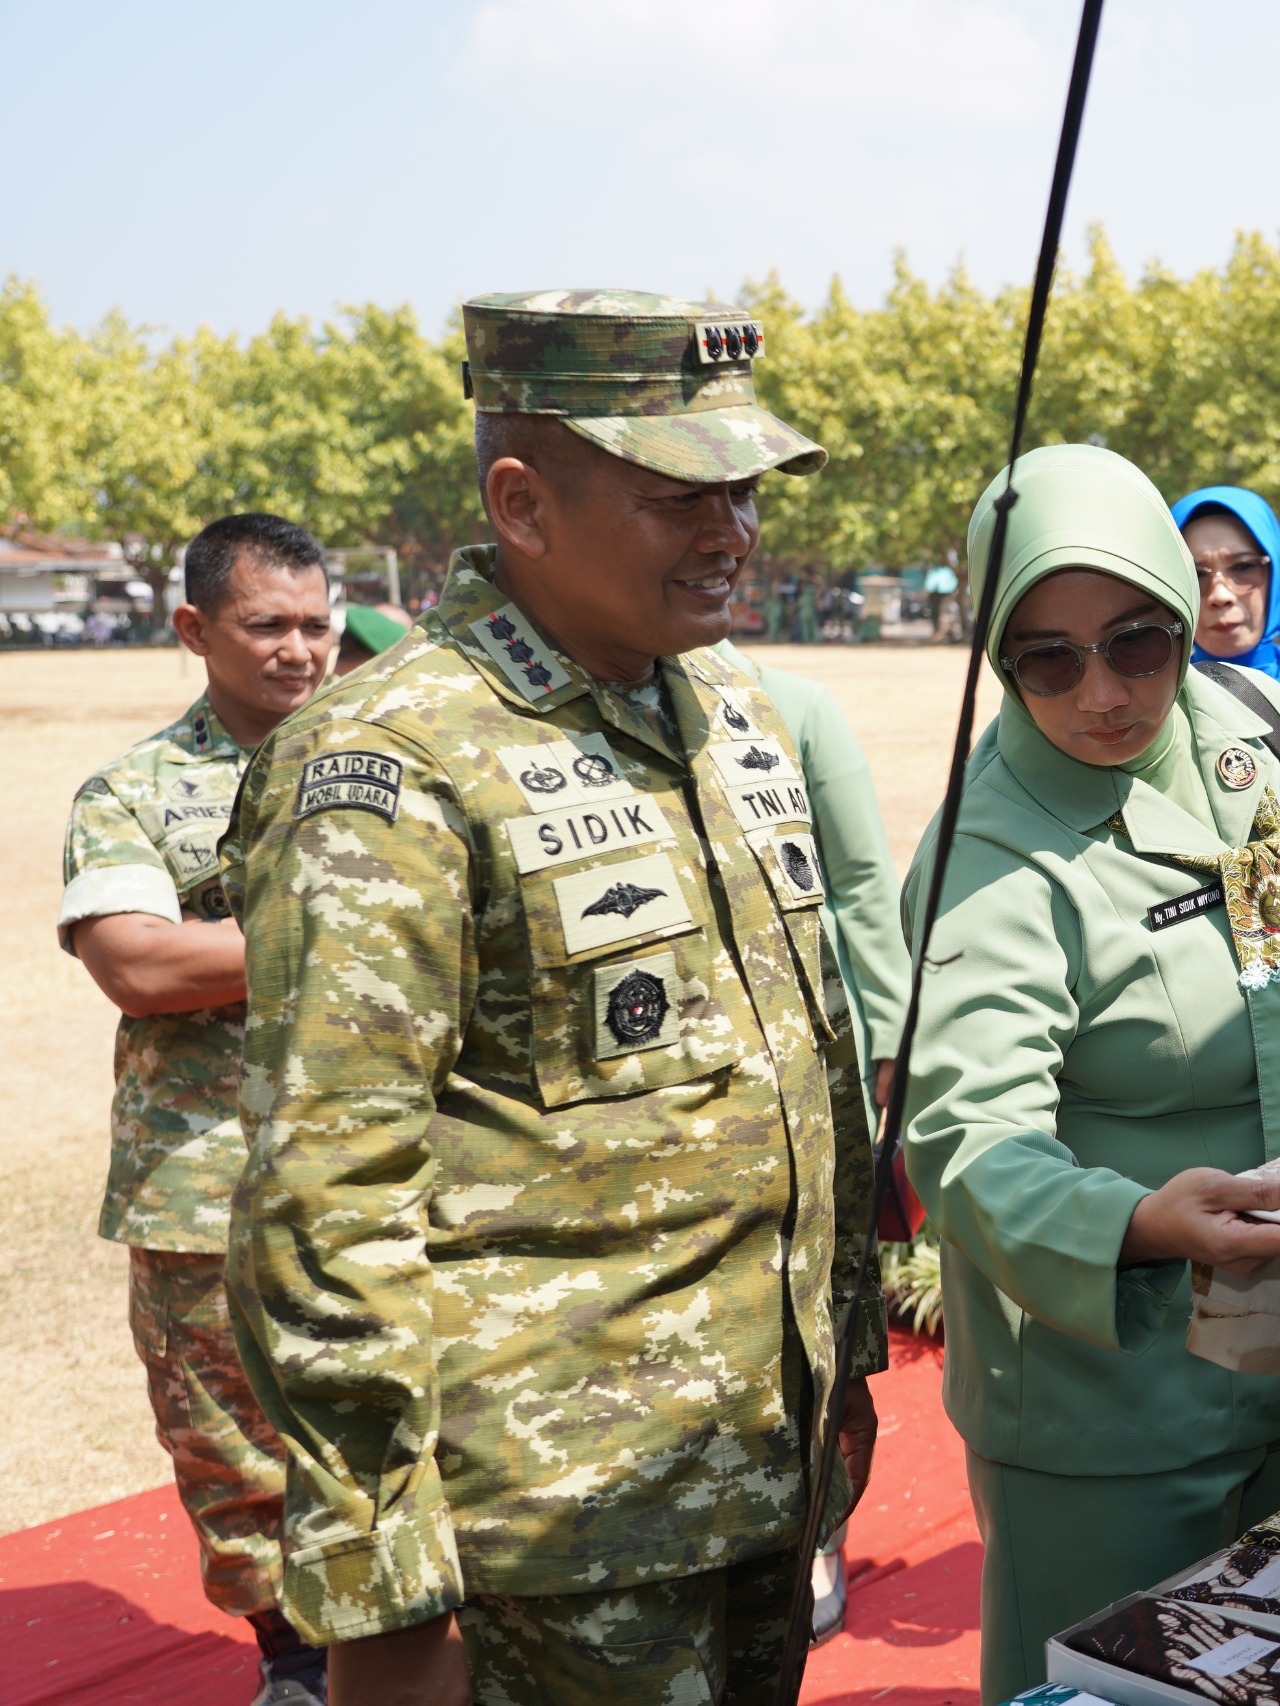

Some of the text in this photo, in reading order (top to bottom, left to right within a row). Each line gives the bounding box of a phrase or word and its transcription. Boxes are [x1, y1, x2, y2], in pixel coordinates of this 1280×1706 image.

[313, 757, 392, 780] RAIDER
[306, 785, 389, 808] MOBIL UDARA
[741, 787, 807, 819] TNI AD
[538, 804, 655, 856] SIDIK
[1154, 911, 1166, 925] Ny.
[1164, 905, 1178, 920] TINI
[1178, 898, 1197, 914] SIDIK
